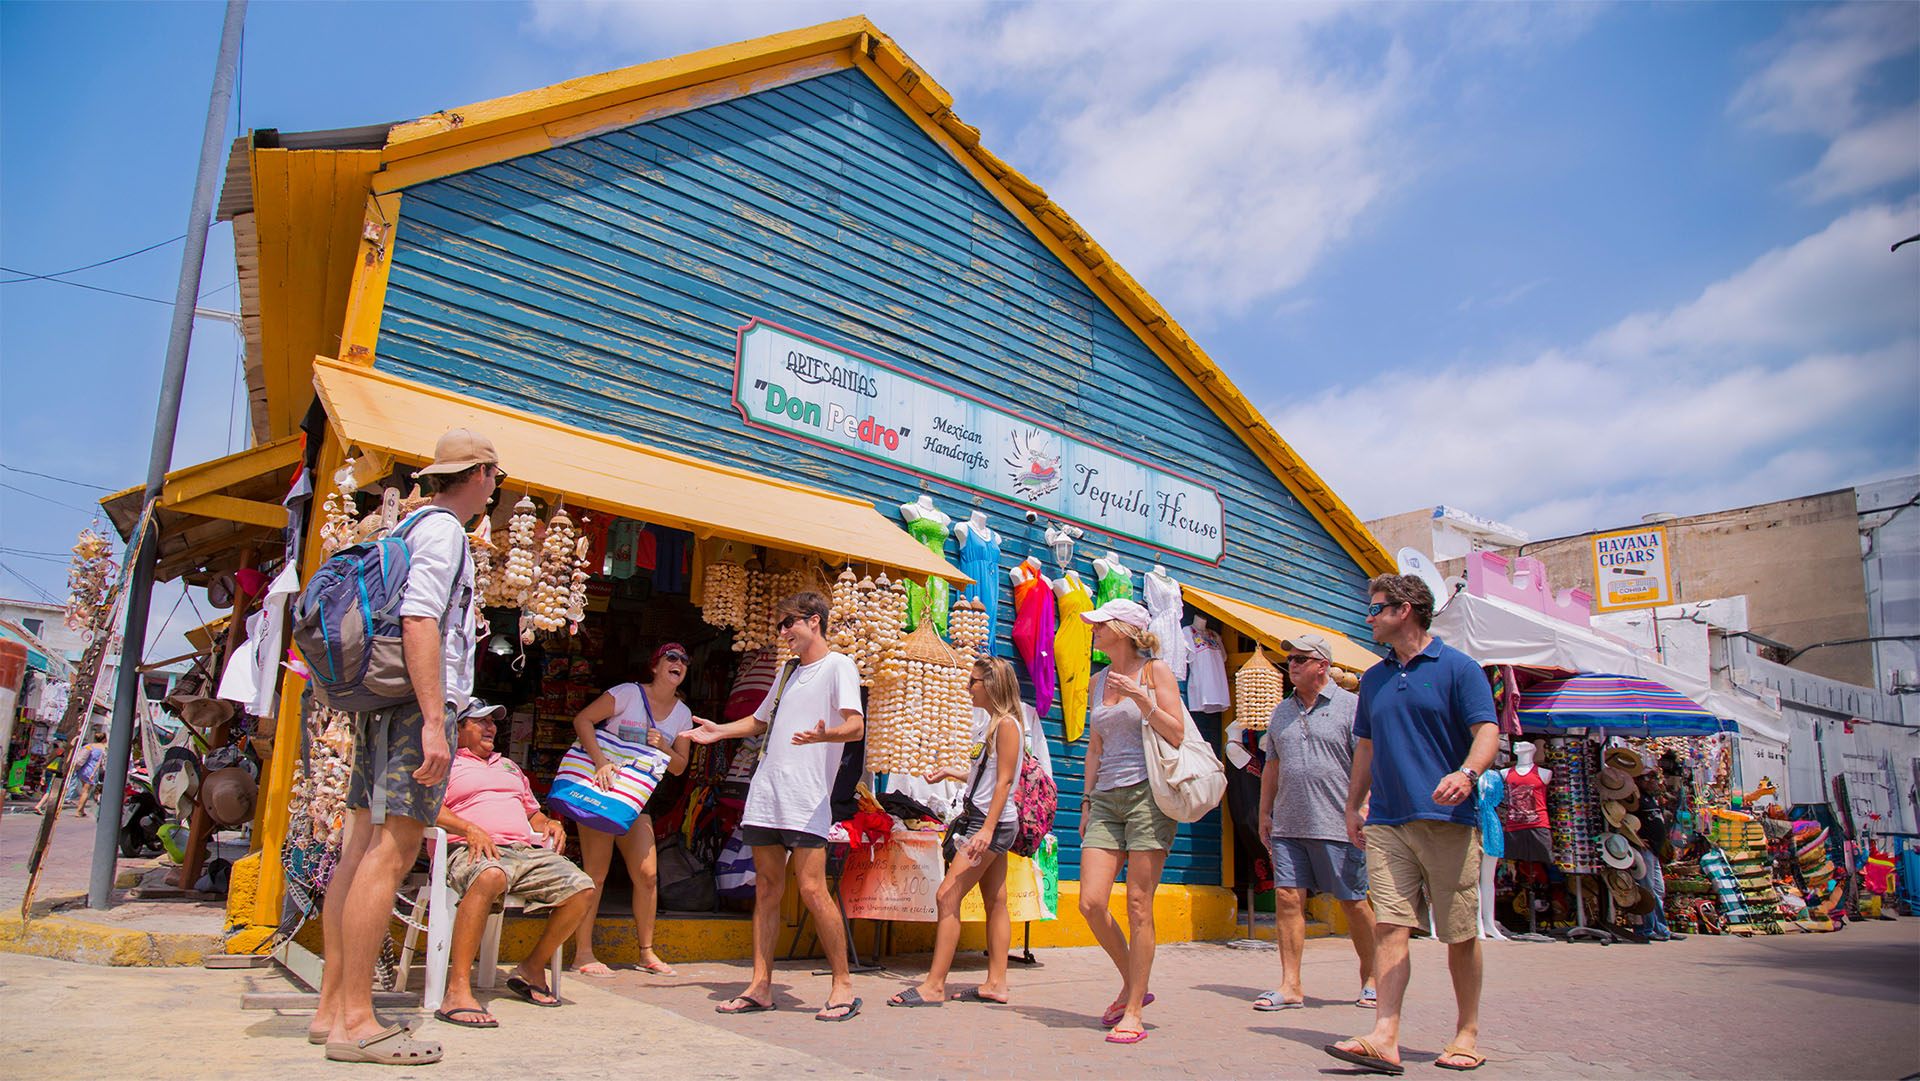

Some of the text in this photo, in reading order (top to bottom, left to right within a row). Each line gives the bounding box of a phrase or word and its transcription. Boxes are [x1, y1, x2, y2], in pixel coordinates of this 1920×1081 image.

[786, 351, 878, 398] ARTESANIAS
[933, 416, 982, 444] Mexican
[923, 436, 989, 470] Handcrafts
[1073, 464, 1217, 539] Tequila House
[1598, 534, 1659, 553] HAVANA
[1600, 548, 1655, 567] CIGARS
